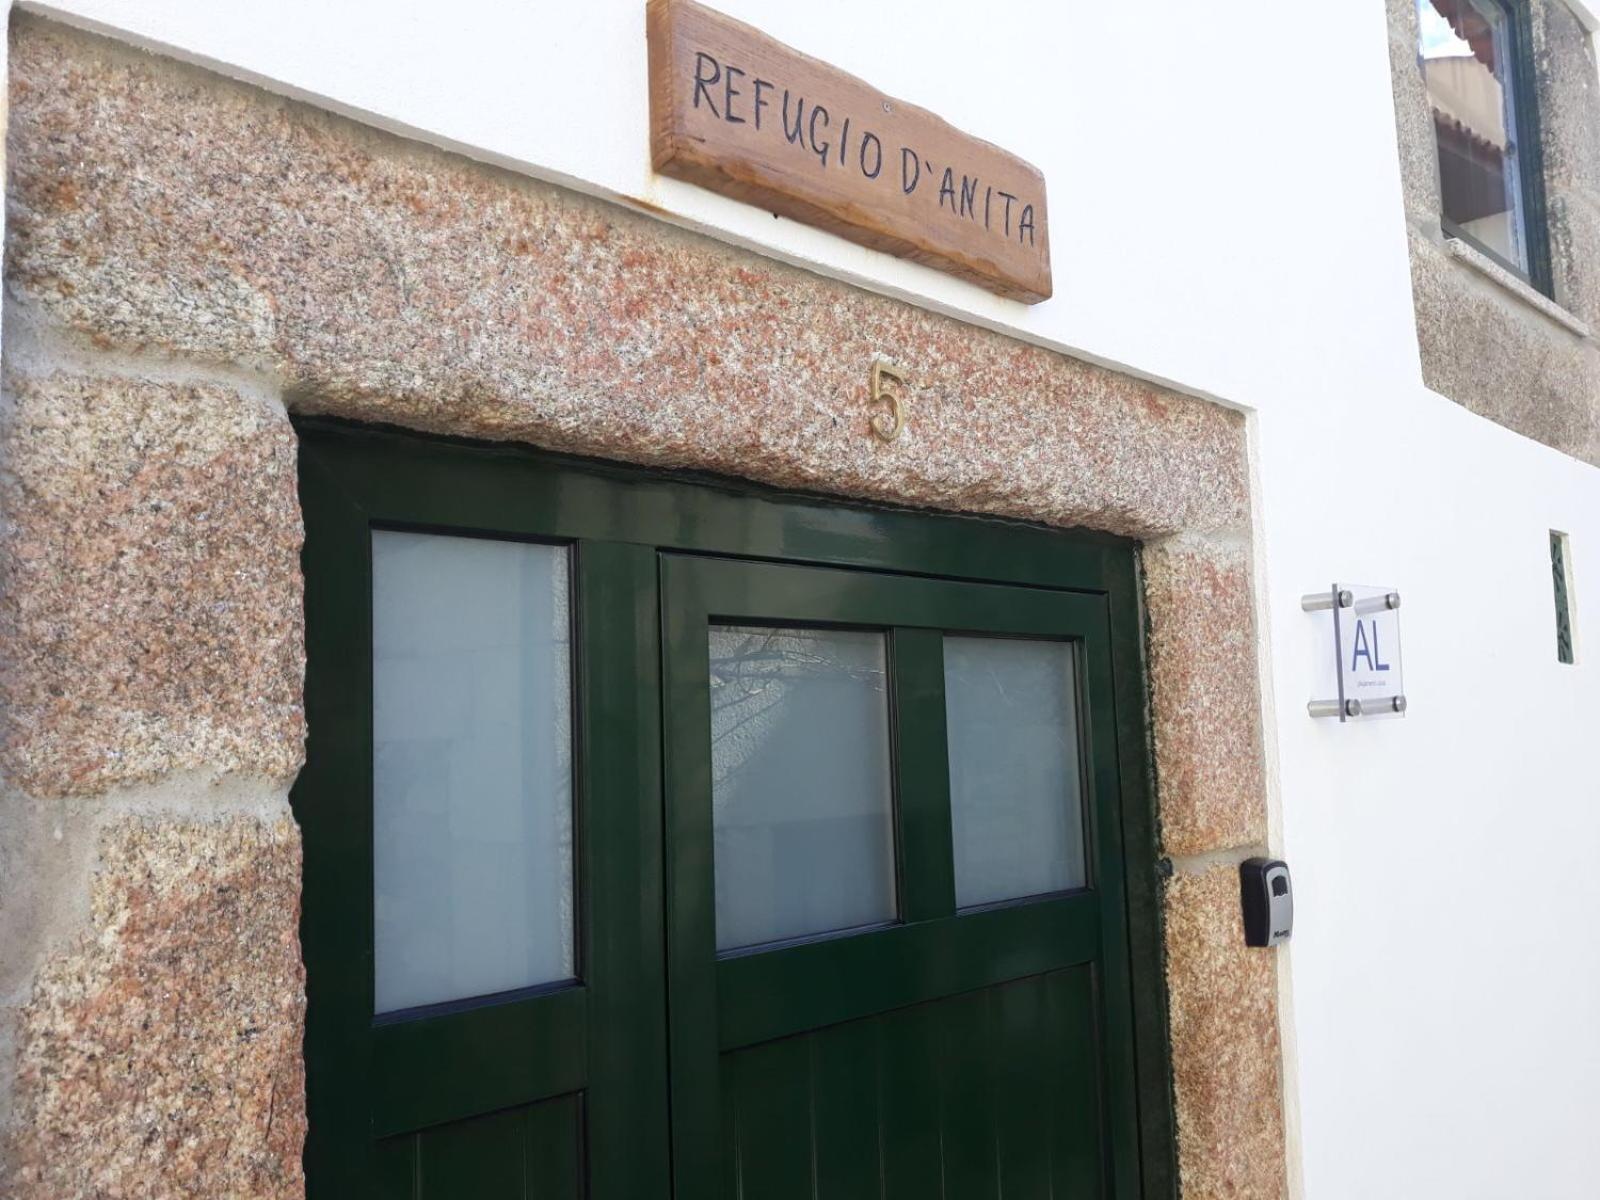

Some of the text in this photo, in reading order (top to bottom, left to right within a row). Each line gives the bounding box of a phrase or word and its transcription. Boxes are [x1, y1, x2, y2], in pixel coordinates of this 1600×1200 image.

[693, 51, 882, 180] REFUGIO
[869, 355, 905, 441] 5
[1352, 619, 1390, 671] AL
